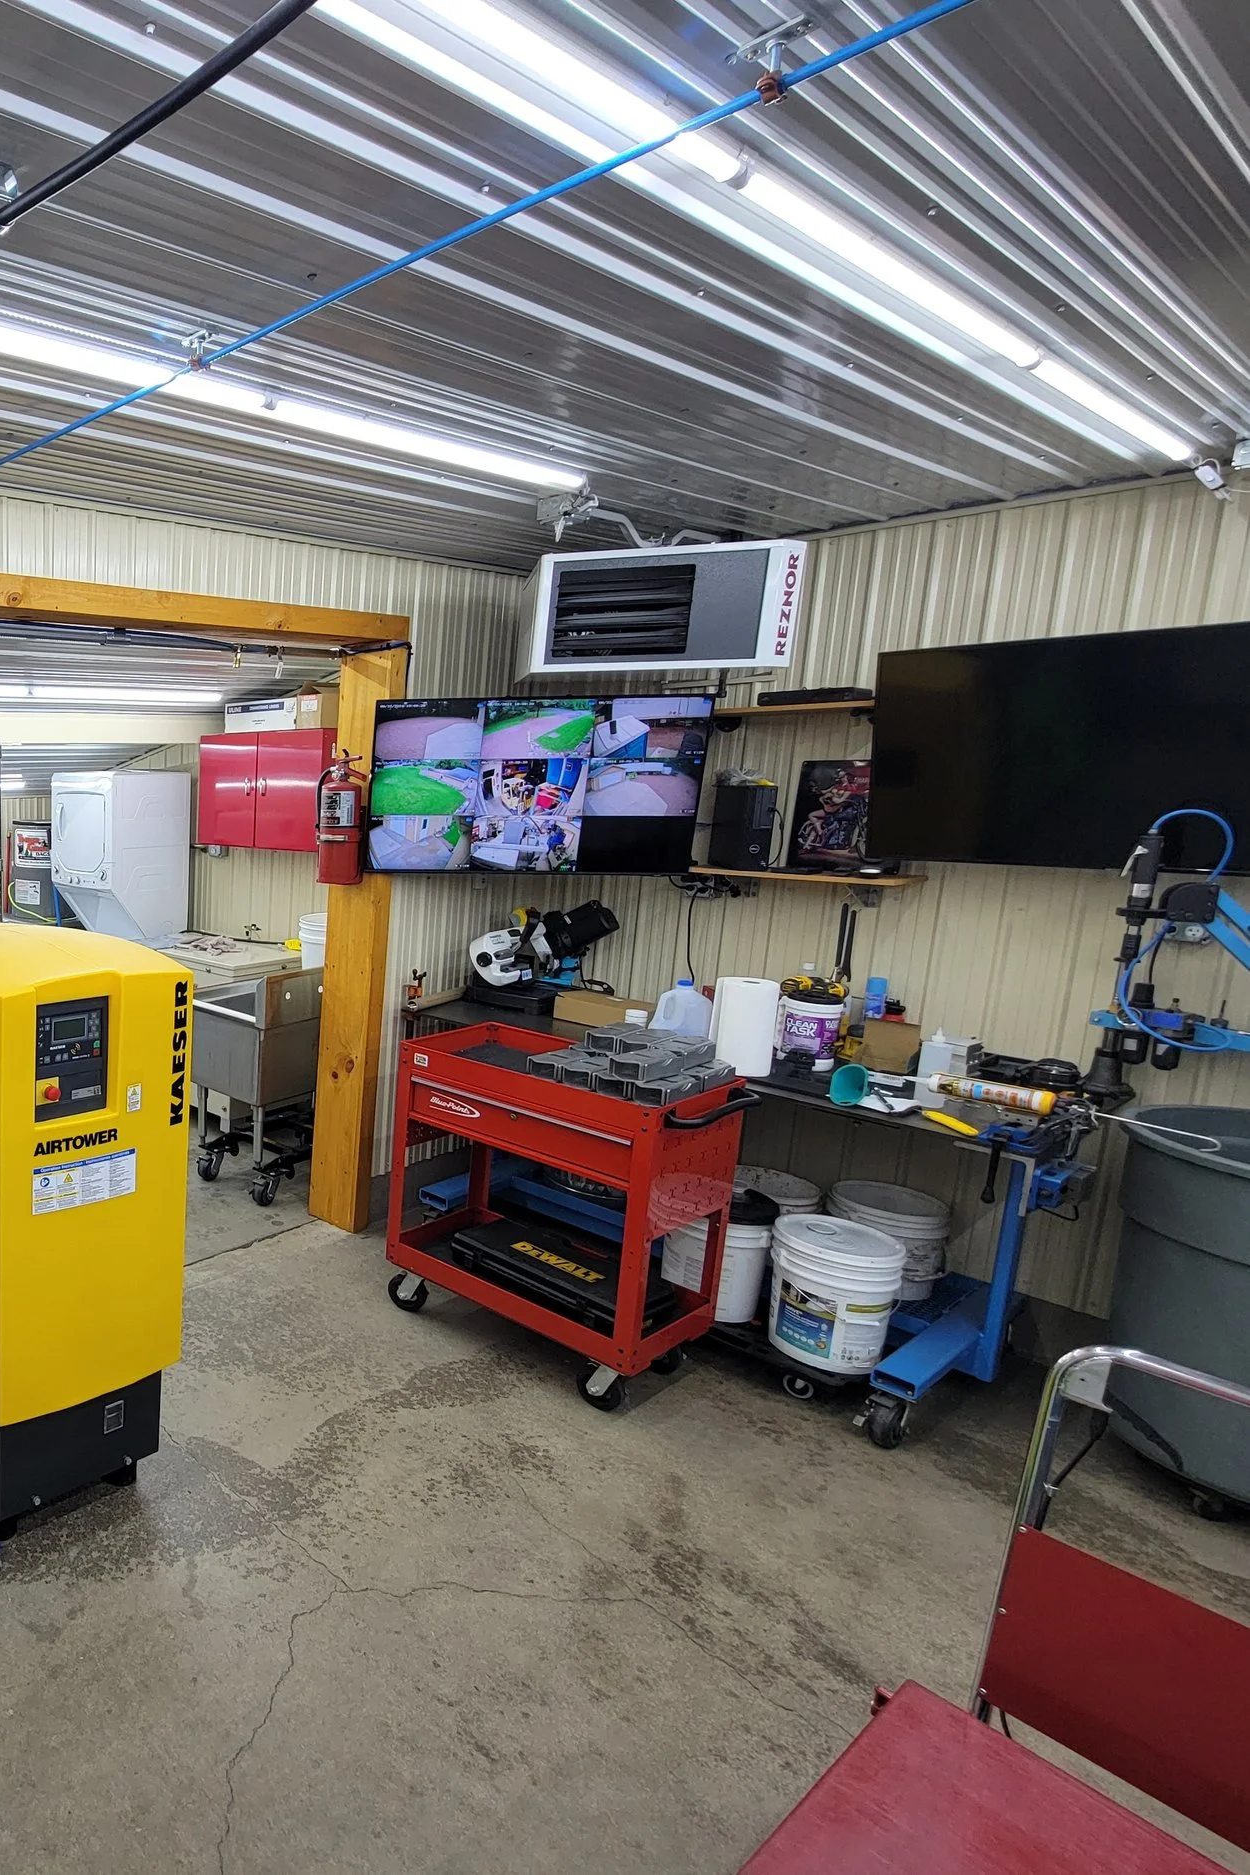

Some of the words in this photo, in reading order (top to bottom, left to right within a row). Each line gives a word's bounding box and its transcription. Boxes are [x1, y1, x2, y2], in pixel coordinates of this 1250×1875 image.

[774, 553, 800, 657] REZNOR
[786, 1017, 818, 1029] CLEAN
[786, 1023, 816, 1037] TASK
[169, 980, 189, 1127] KAESER
[430, 1096, 470, 1115] Blue-Point
[33, 1128, 118, 1157] AIRTOWER
[510, 1241, 607, 1283] DEWALT
